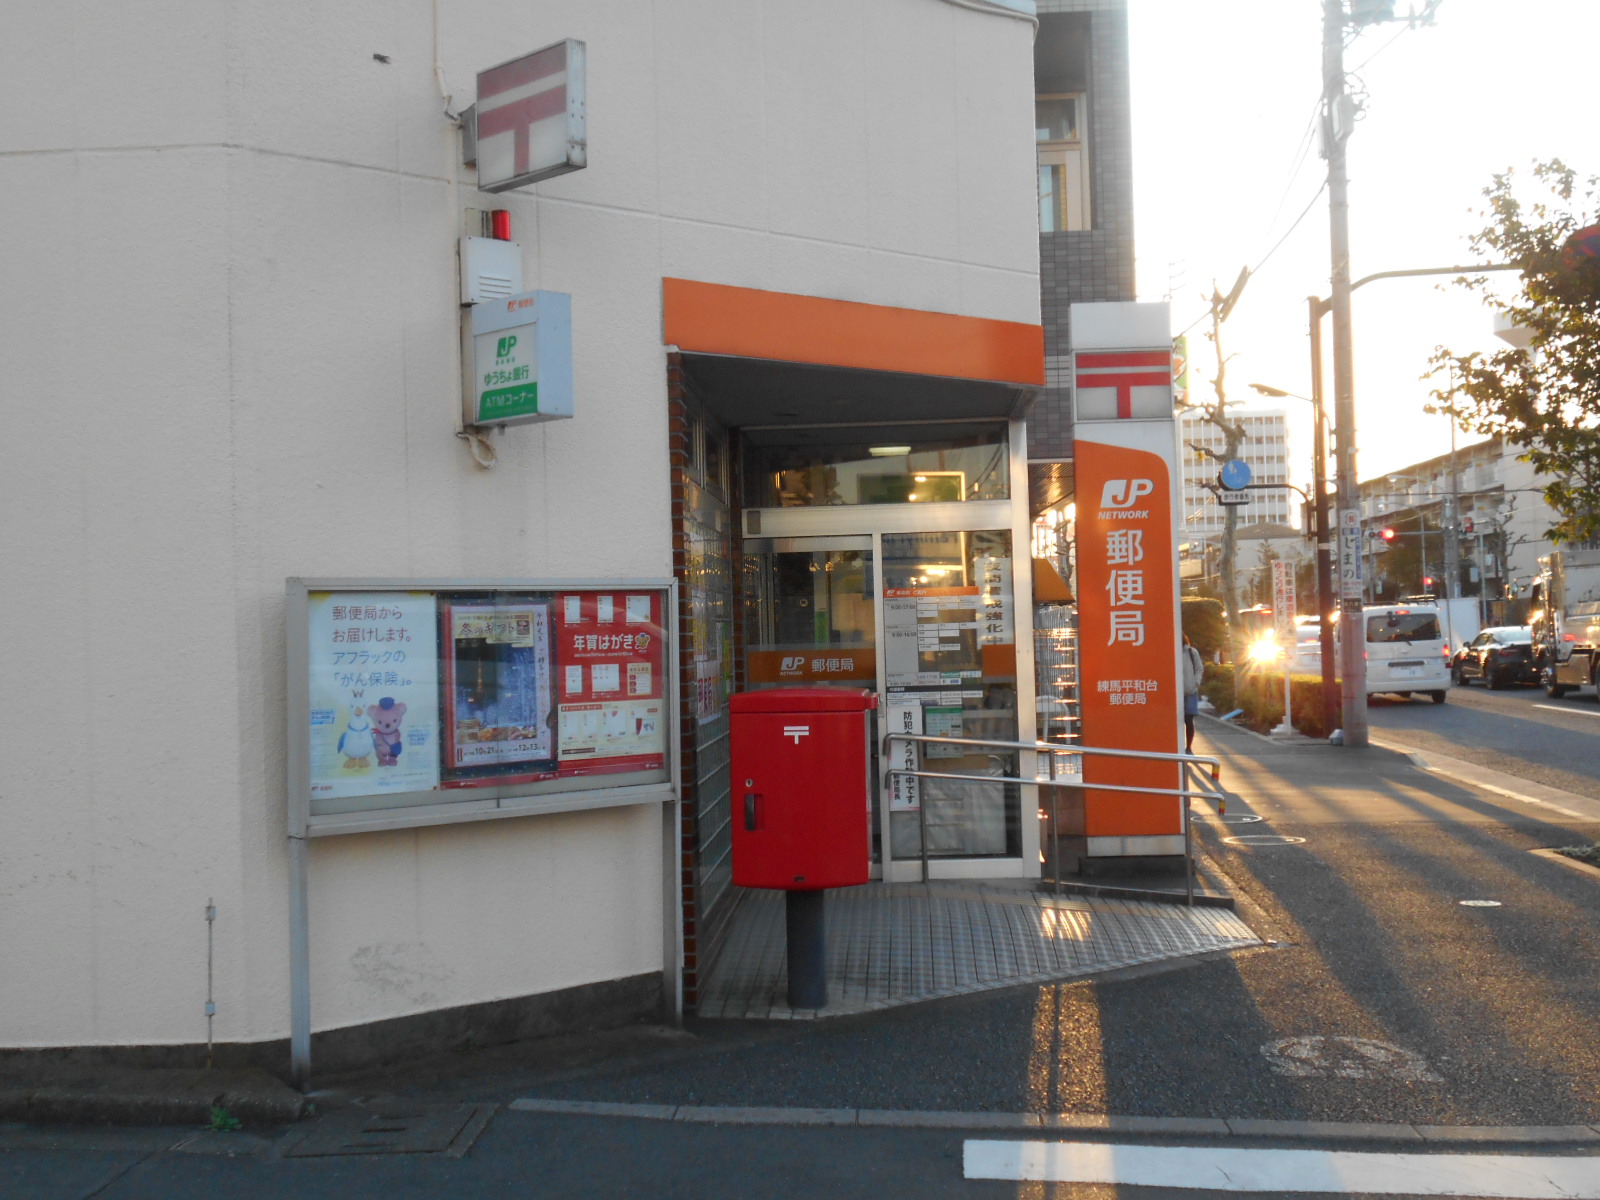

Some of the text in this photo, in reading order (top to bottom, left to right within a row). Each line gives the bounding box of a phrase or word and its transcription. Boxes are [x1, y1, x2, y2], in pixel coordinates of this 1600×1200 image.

[496, 335, 518, 358] JP
[484, 365, 529, 386] ゆうちょ銀行
[486, 392, 534, 408] ATMコーナー
[1100, 479, 1154, 508] JP
[1098, 510, 1150, 520] NETWORK
[1106, 529, 1145, 646] 郵便局
[332, 606, 402, 621] 郵便局から
[332, 627, 411, 643] お届けします。
[460, 622, 515, 637] 冬のギフト
[573, 634, 634, 650] 年賀はがき
[332, 650, 406, 665] アフラックの
[812, 658, 854, 672] 郵便局
[334, 672, 412, 687] 「がん保険」。
[1097, 680, 1158, 692] 練馬平和台
[1110, 693, 1147, 705] 郵便局
[903, 711, 915, 804] 防犯メラ作中です
